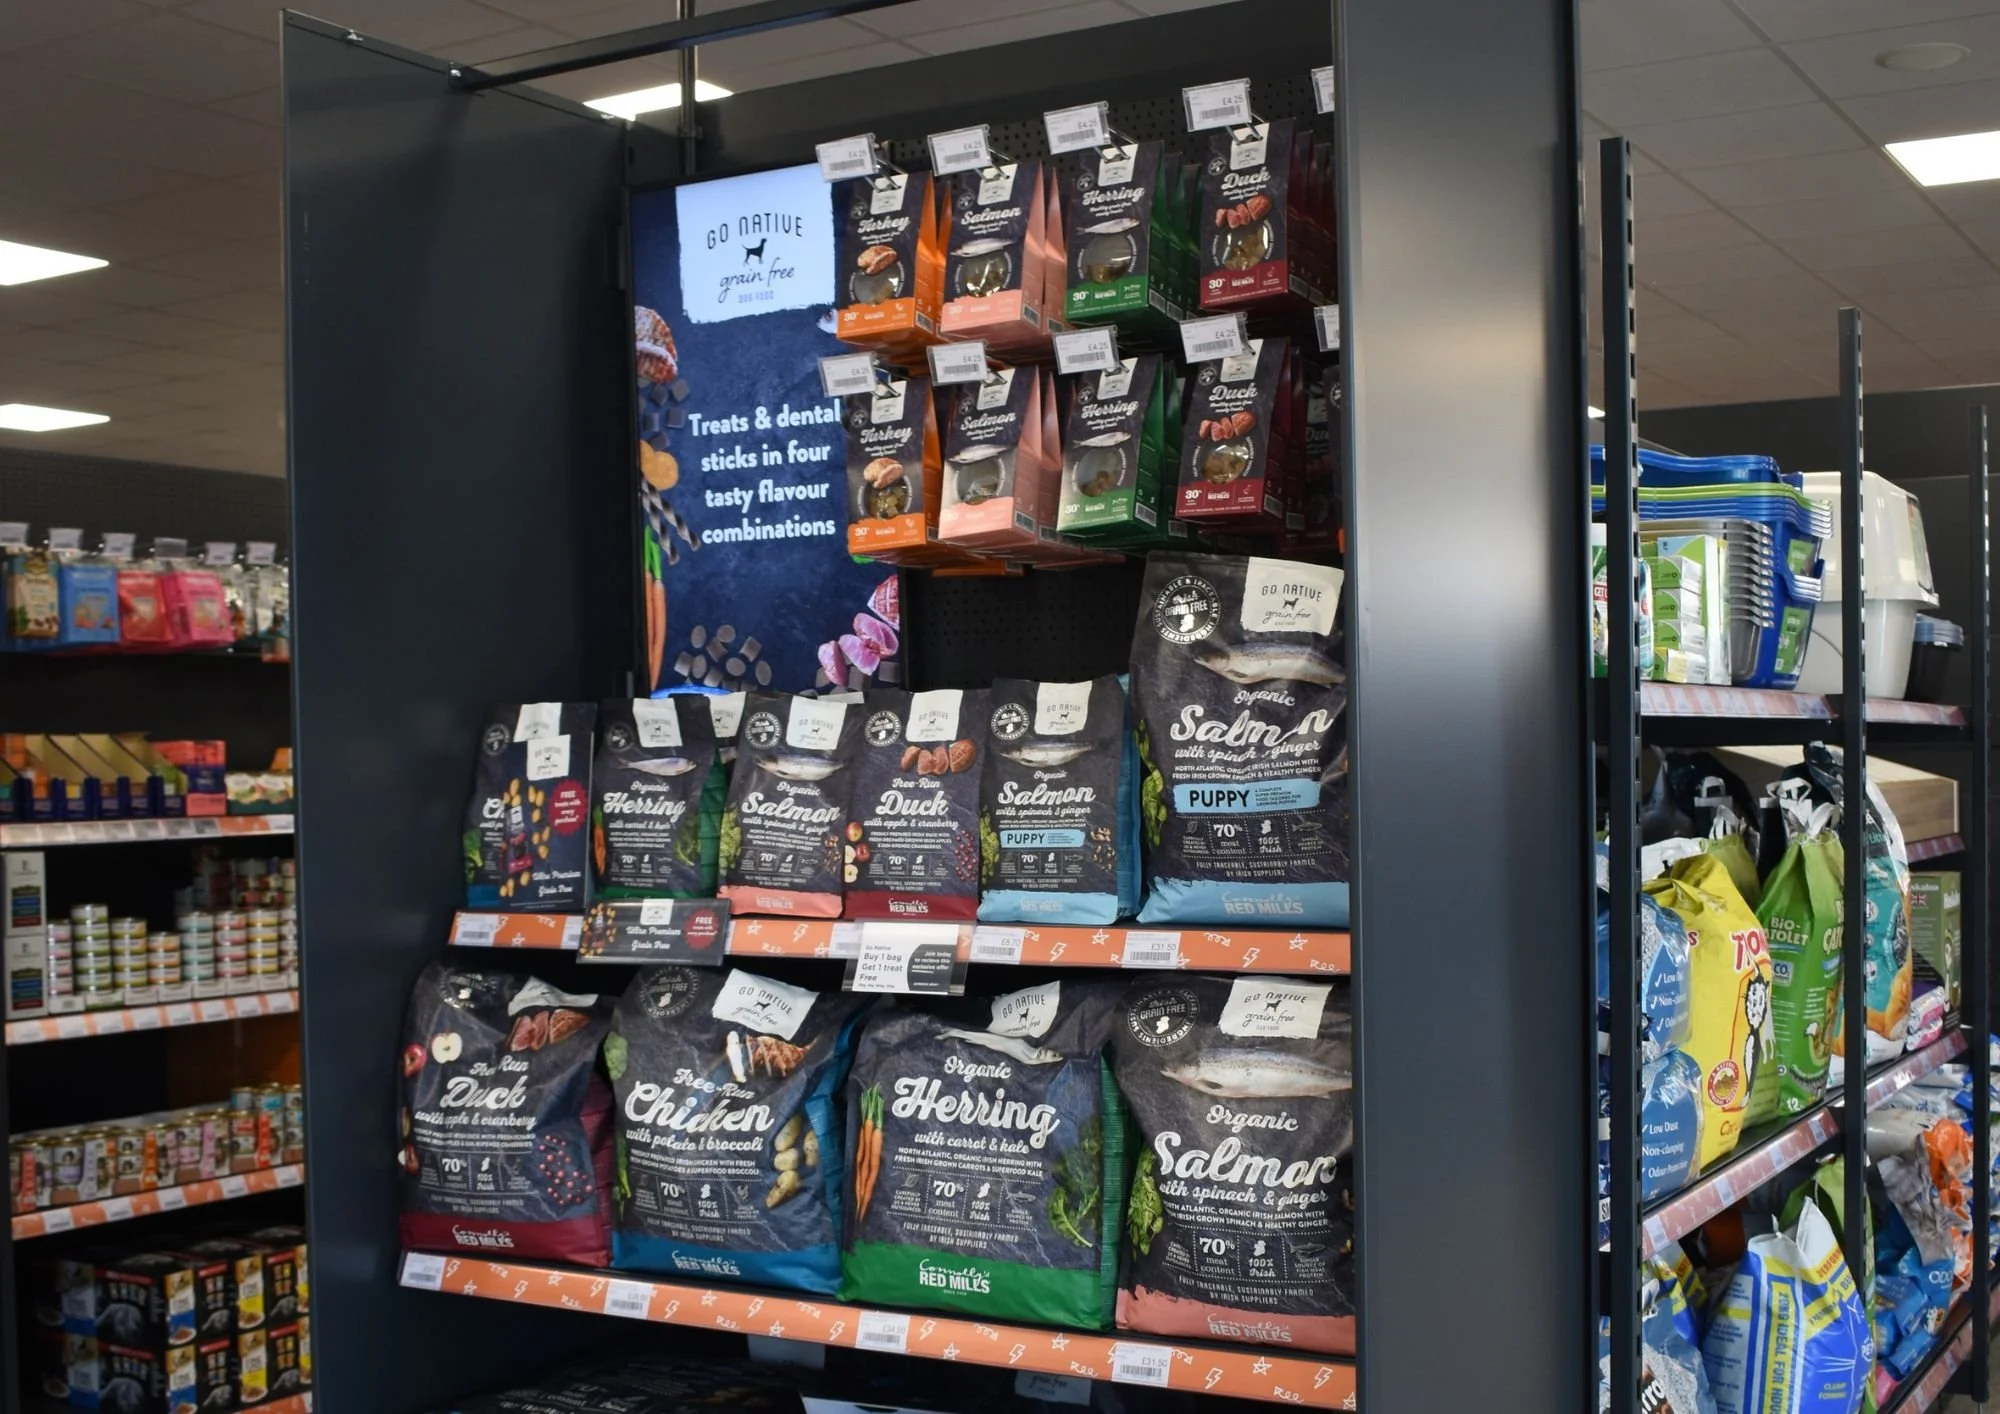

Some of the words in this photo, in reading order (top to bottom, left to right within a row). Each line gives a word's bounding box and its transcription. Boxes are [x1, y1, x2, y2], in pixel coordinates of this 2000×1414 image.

[1222, 95, 1243, 106] £4.25
[1221, 166, 1271, 190] Duck
[1082, 186, 1144, 206] Herring
[857, 215, 911, 234] Turkey
[961, 207, 1022, 226] Salmon
[707, 223, 729, 250] GO
[739, 212, 803, 238] NATIVE
[718, 268, 764, 304] grain
[767, 257, 795, 288] free
[1208, 382, 1259, 401] Duck
[688, 413, 749, 436] Treats
[754, 406, 772, 430] &
[776, 398, 841, 428] dental
[1081, 400, 1139, 420] Herring
[960, 411, 1016, 431] Salmon
[860, 425, 913, 444] Turkey
[701, 445, 757, 472] sticks
[762, 443, 782, 466] in
[787, 440, 831, 464] four
[705, 487, 754, 514] tasty
[758, 478, 830, 503] flavour
[701, 514, 836, 544] combinations
[1261, 585, 1277, 597] GO
[1282, 583, 1323, 602] NATIVE
[1190, 600, 1208, 613] FREE
[1233, 690, 1296, 707] Organic
[1170, 704, 1334, 747] Salmn
[1264, 769, 1294, 777] HEALTHY
[776, 781, 820, 797] Organic
[998, 781, 1096, 806] Salmon
[603, 792, 686, 823] Herring
[741, 792, 841, 823] Salmon
[875, 790, 949, 816] Duck
[1189, 790, 1249, 807] PUPPY
[996, 807, 1015, 815] with
[1018, 808, 1052, 818] spinach
[1060, 806, 1091, 817] ginger
[864, 818, 882, 826] with
[884, 819, 907, 829] apple
[910, 819, 916, 827] &
[918, 819, 959, 831] cranberry
[1213, 824, 1242, 837] 70%
[1007, 833, 1045, 844] PUPPY
[1224, 902, 1256, 914] RED
[1257, 902, 1304, 914] MILLS
[649, 926, 681, 935] Premium
[1151, 943, 1177, 951] £31.50
[864, 953, 878, 961] Buy
[738, 986, 754, 995] GO
[758, 988, 793, 1015] NATIVE
[1003, 1003, 1013, 1019] GO
[1015, 994, 1045, 1009] NATIVE
[1244, 995, 1259, 1003] GO
[1265, 992, 1308, 1003] NATIVE
[1140, 1008, 1164, 1020] GRAIN
[1167, 1003, 1186, 1014] FREE
[1242, 1013, 1275, 1027] grain
[1278, 1010, 1295, 1024] free
[944, 1055, 1011, 1083] Organic
[440, 1075, 528, 1109] Duck
[672, 1068, 755, 1100] Free-Run
[624, 1081, 775, 1133] Chicken
[891, 1076, 1061, 1149] Herring
[1206, 1104, 1299, 1133] Organic
[1650, 1124, 1663, 1134] Low
[1665, 1122, 1678, 1132] Dust
[626, 1127, 652, 1143] with
[706, 1135, 764, 1152] broccoli
[915, 1131, 945, 1145] with
[947, 1134, 986, 1149] carrot
[989, 1139, 998, 1150] &
[1000, 1137, 1030, 1154] kale
[916, 1157, 933, 1165] IRISH
[934, 1160, 957, 1168] GROWN
[958, 1163, 986, 1171] CARROTS
[992, 1166, 1026, 1175] SUPERFOOD
[1027, 1169, 1043, 1177] KALE
[953, 1154, 981, 1162] ORGANIC
[1154, 1131, 1339, 1189] Salmon
[661, 1182, 685, 1197] 70%
[933, 1180, 964, 1197] 70%
[928, 1208, 959, 1218] content
[972, 1201, 990, 1210] 100%
[970, 1211, 990, 1221] Irish
[1177, 1212, 1195, 1221] IRISH
[1197, 1214, 1225, 1224] GROWN
[1226, 1218, 1256, 1227] SPINACH
[1258, 1220, 1263, 1228] &
[1265, 1221, 1297, 1230] HEALTHY
[1300, 1218, 1328, 1228] GINGER
[1252, 1212, 1273, 1220] IRISH
[1305, 1210, 1325, 1218] WITH
[903, 1222, 920, 1230] FULLY
[938, 1237, 954, 1245] IRISH
[956, 1239, 987, 1249] SUPPLIERS
[1200, 1237, 1235, 1255] 70%
[675, 1259, 700, 1269] RED
[702, 1262, 740, 1275] MILLS
[1201, 1265, 1235, 1275] content
[1206, 1257, 1228, 1265] meat
[1249, 1258, 1274, 1267] 100%
[1250, 1268, 1276, 1277] Irish
[920, 1271, 946, 1287] RED
[950, 1277, 990, 1293] MILLS
[1221, 1293, 1239, 1301] IRISH
[1242, 1295, 1278, 1305] SUPPLIERS
[1285, 1288, 1313, 1296] FARMED
[1209, 1323, 1241, 1337] RED
[1244, 1327, 1292, 1342] MILLS
[1775, 1324, 1789, 1357] IDEAL
[1141, 1357, 1168, 1367] £31.50
[1772, 1361, 1786, 1389] FOR
